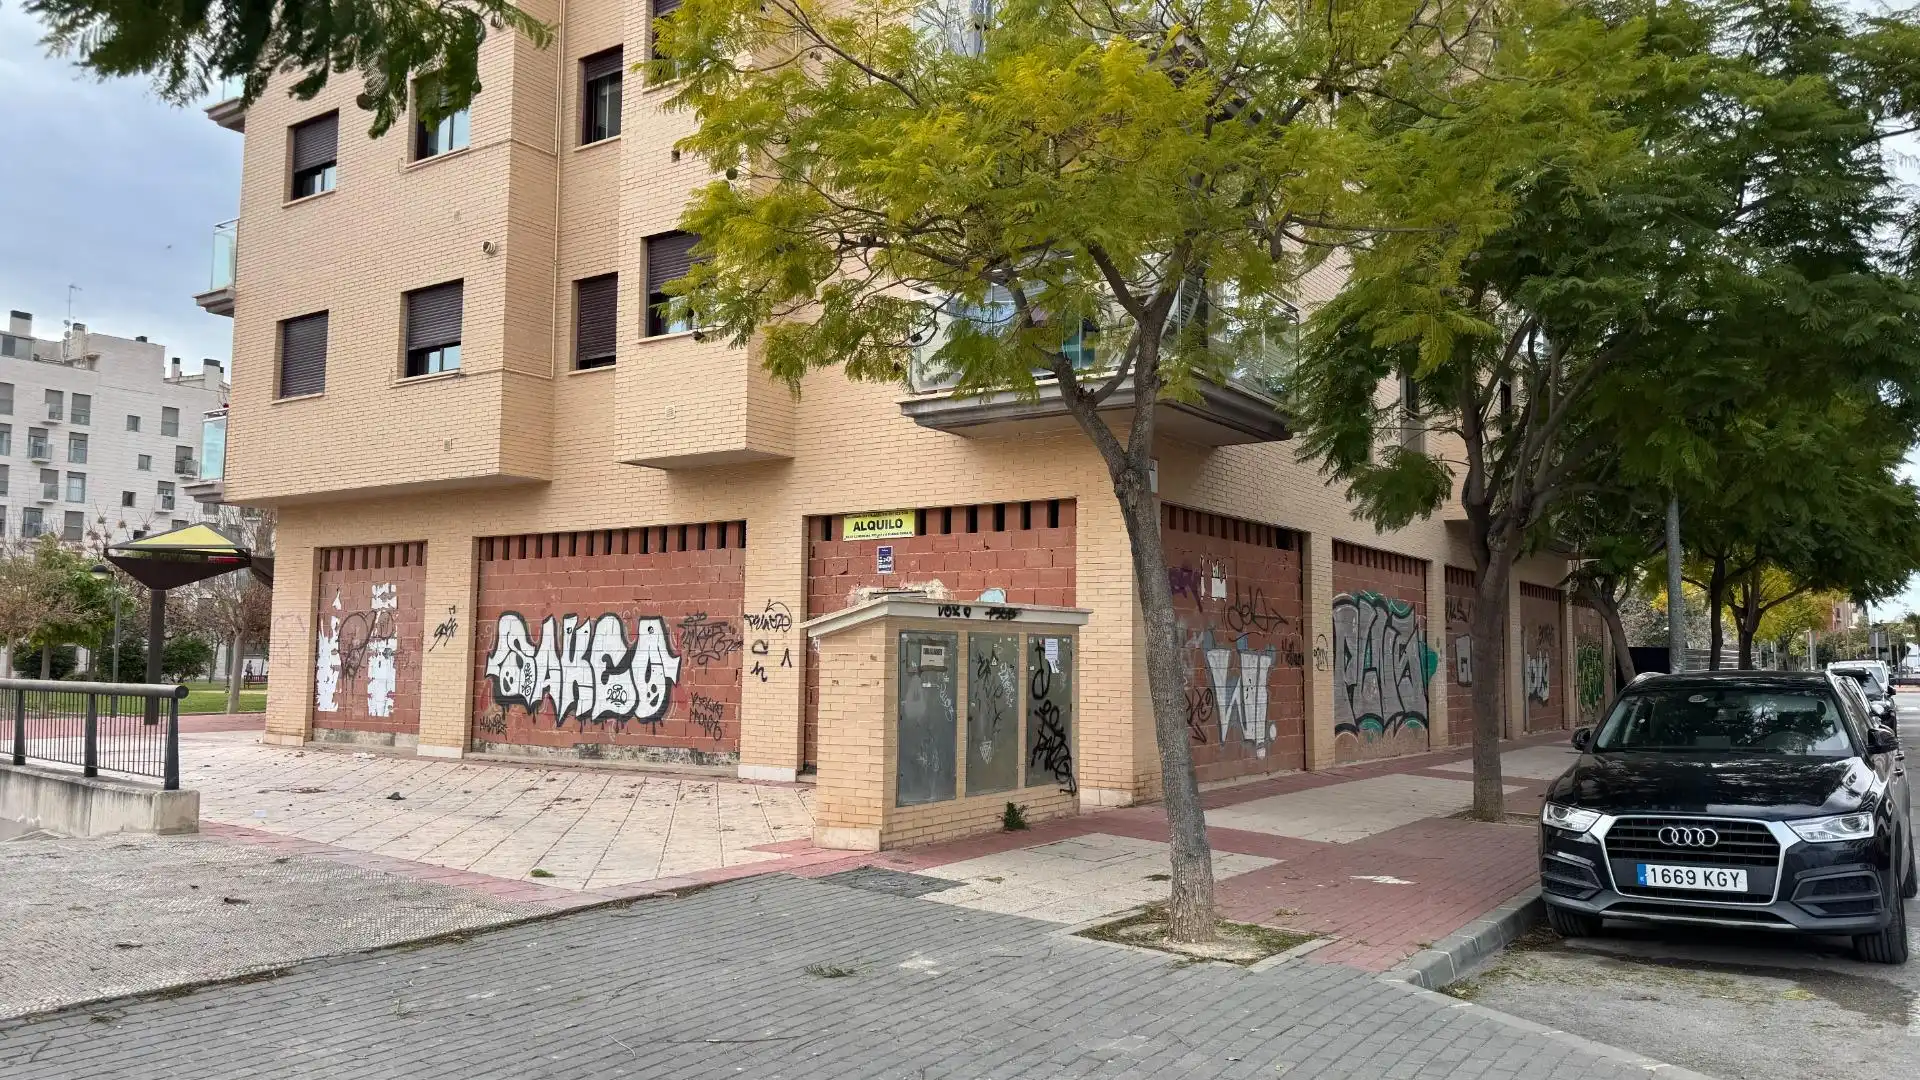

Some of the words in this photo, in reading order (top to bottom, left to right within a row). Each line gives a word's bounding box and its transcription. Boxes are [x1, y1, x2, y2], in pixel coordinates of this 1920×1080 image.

[853, 518, 903, 531] ALQUILO
[606, 688, 628, 704] 2020
[1651, 868, 1697, 885] 1669
[1703, 870, 1739, 888] KGY
